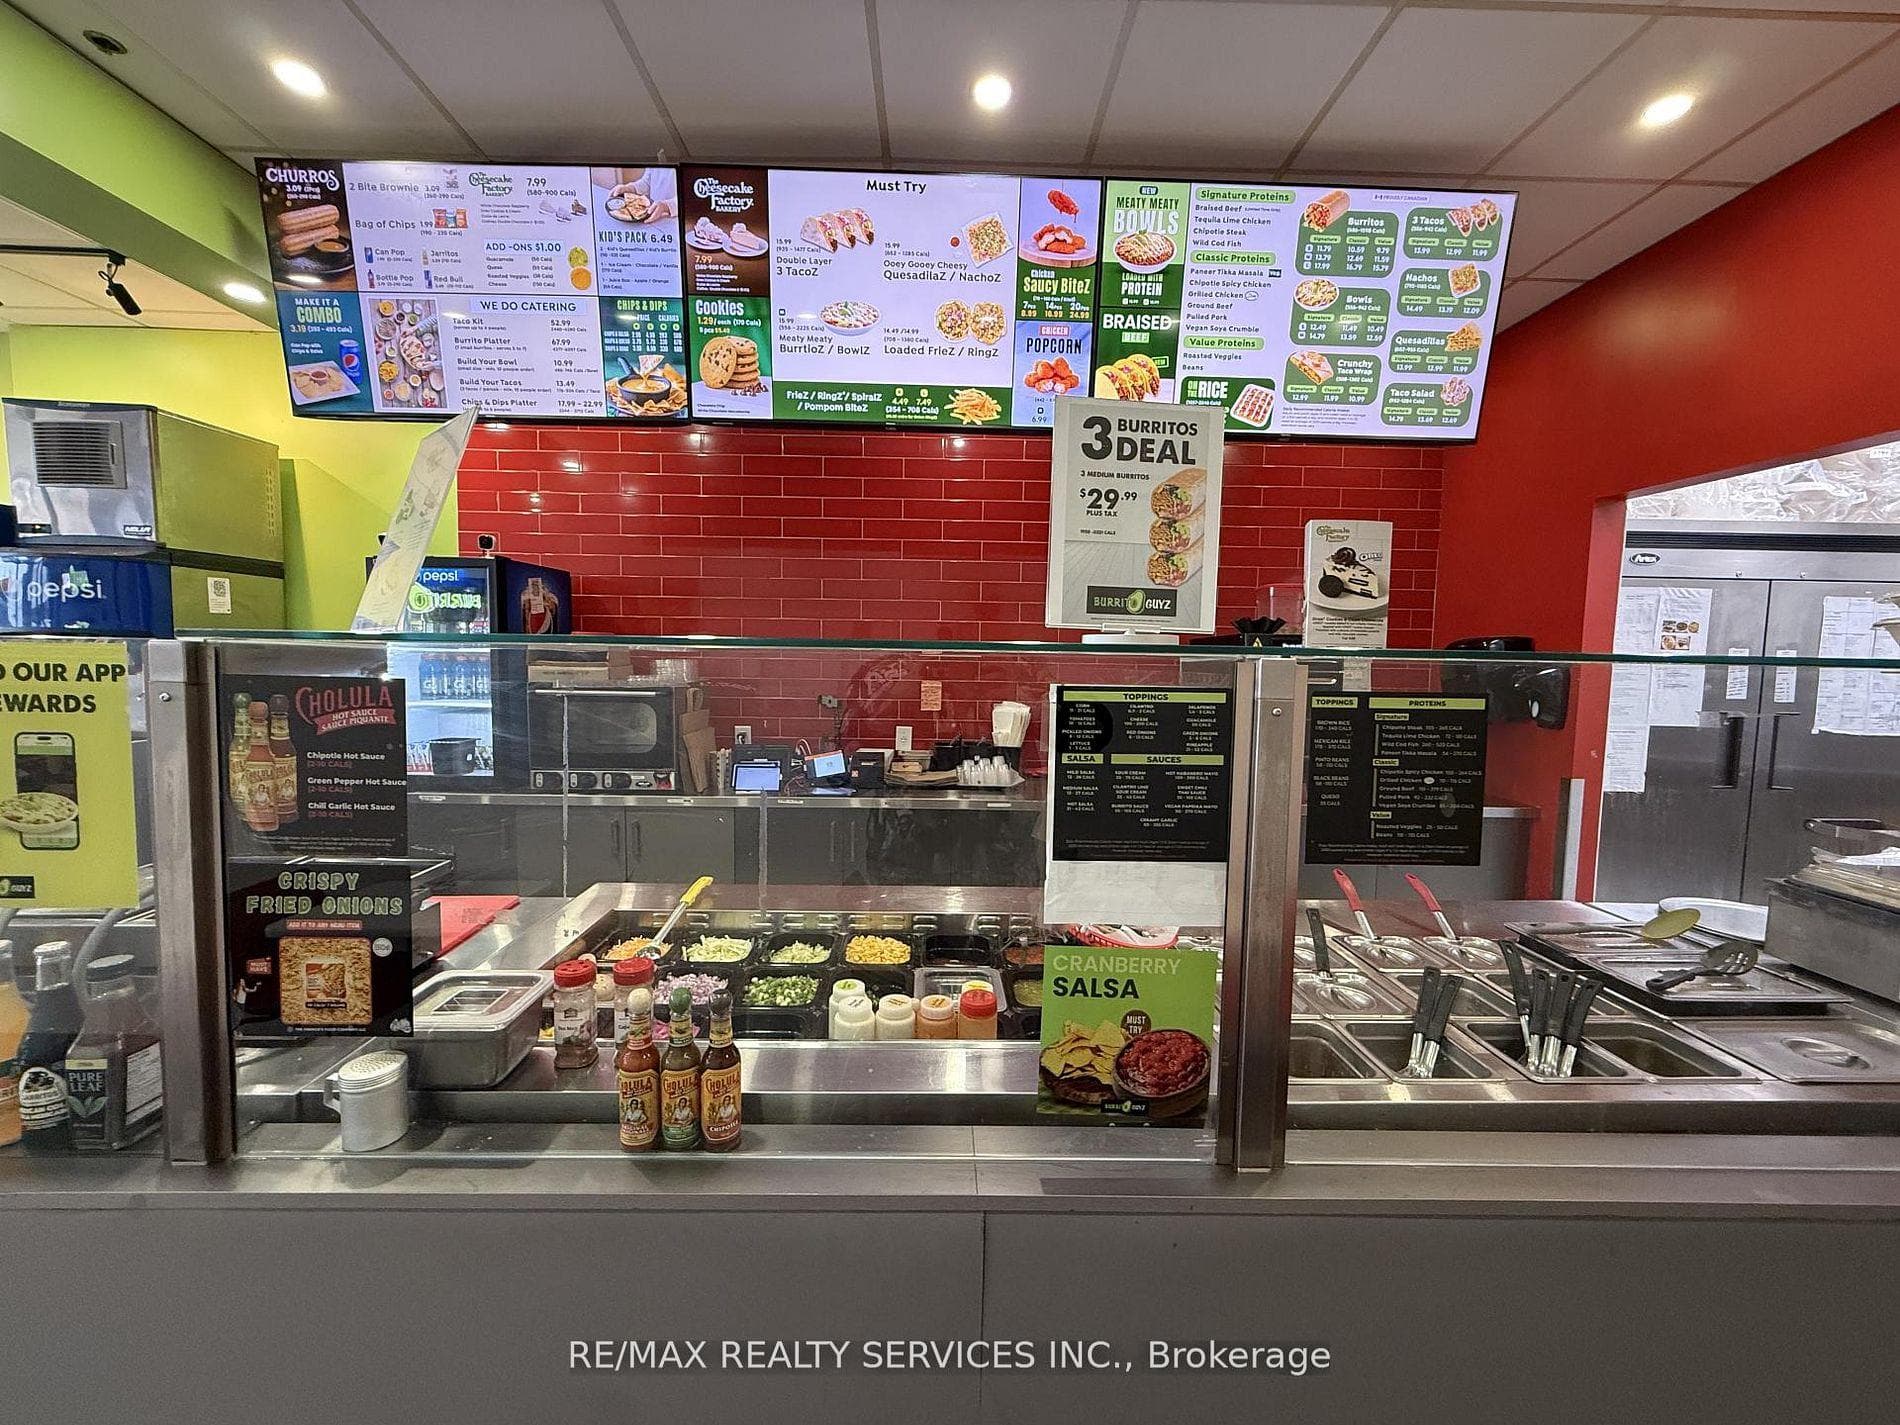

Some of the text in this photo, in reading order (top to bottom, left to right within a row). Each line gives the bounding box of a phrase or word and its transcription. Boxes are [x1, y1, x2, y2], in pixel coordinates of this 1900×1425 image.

[265, 167, 339, 191] CHURROS
[527, 178, 546, 187] 7.99
[358, 182, 419, 192] Bite Brownie
[694, 178, 754, 198] Cheesecake
[867, 180, 926, 194] Must Try
[1201, 189, 1290, 201] Signature Proteins
[1116, 197, 1179, 209] MEATY MEATY
[1195, 204, 1223, 212] Braised
[355, 220, 374, 229] Bag
[389, 220, 415, 229] Chips
[1114, 209, 1179, 234] BOWLS
[1242, 217, 1271, 225] Chicken
[1348, 218, 1384, 226] Burritos
[1420, 217, 1445, 225] Tacos
[625, 232, 673, 243] PACK 6.49
[536, 243, 561, 251] $1.00
[375, 248, 405, 257] Can Pop
[695, 256, 712, 264] 7.99
[776, 256, 807, 265] Double
[1195, 253, 1270, 263] Classic Proteins
[884, 260, 967, 270] Ooey Cheesy
[776, 267, 818, 276] 3 TacoZ
[400, 275, 414, 284] Pop
[959, 272, 1001, 282] NachoZ
[1406, 274, 1437, 282] Nachos
[1024, 277, 1090, 295] Saucy BiteZ
[1121, 282, 1163, 296] PROTEIN
[1222, 280, 1241, 289] Spicy
[1215, 291, 1243, 299] Chicken
[1346, 295, 1372, 303] Bowls
[295, 298, 319, 306] MAKE
[480, 301, 576, 311] WE DO CATERING
[617, 300, 667, 311] CHIPS DIPS
[696, 299, 744, 316] Cookies
[297, 307, 342, 323] COMBO
[1103, 314, 1172, 330] BRAISED
[1210, 325, 1227, 333] Soya
[1229, 325, 1260, 333] Crumble
[780, 335, 833, 344] Meaty Meaty
[1189, 338, 1256, 348] Value Proteins
[1395, 336, 1445, 345] Quesadillas
[838, 345, 870, 355] BowlZ
[884, 345, 999, 357] Loaded RingZ
[1027, 338, 1082, 354] POPCORN
[1337, 360, 1373, 368] Crunchy
[1198, 381, 1228, 398] RICE
[1391, 389, 1410, 397] Taco
[804, 402, 843, 412] Pompom
[1081, 415, 1198, 460] 3 BURRITOS
[1116, 436, 1196, 465] DEAL
[1087, 470, 1150, 480] MEDIUM BURRITOS
[1104, 510, 1118, 518] TAX
[423, 570, 458, 583] pepsi
[27, 579, 102, 603] pepsi
[1145, 599, 1171, 610] GUYZ
[13, 662, 126, 682] OUR APP
[1123, 693, 1168, 701] TOPPINGS
[0, 694, 96, 713] WARDS
[295, 685, 393, 725] CHOLULA
[332, 712, 349, 721] HOT
[322, 720, 347, 730] SAUCE
[307, 752, 341, 760] Chipotle
[308, 777, 332, 785] Green
[334, 778, 363, 786] Pepper
[308, 802, 327, 810] Chili
[328, 802, 352, 810] Garlic
[278, 871, 360, 891] CRISPY
[246, 896, 403, 915] FRIED ONIONS
[1053, 955, 1181, 975] CRANBERRY
[1053, 976, 1139, 999] SALSA
[1126, 1016, 1146, 1024] MUST
[1129, 1026, 1143, 1034] TRY
[69, 1072, 103, 1081] PURE
[70, 1082, 102, 1091] LEAF
